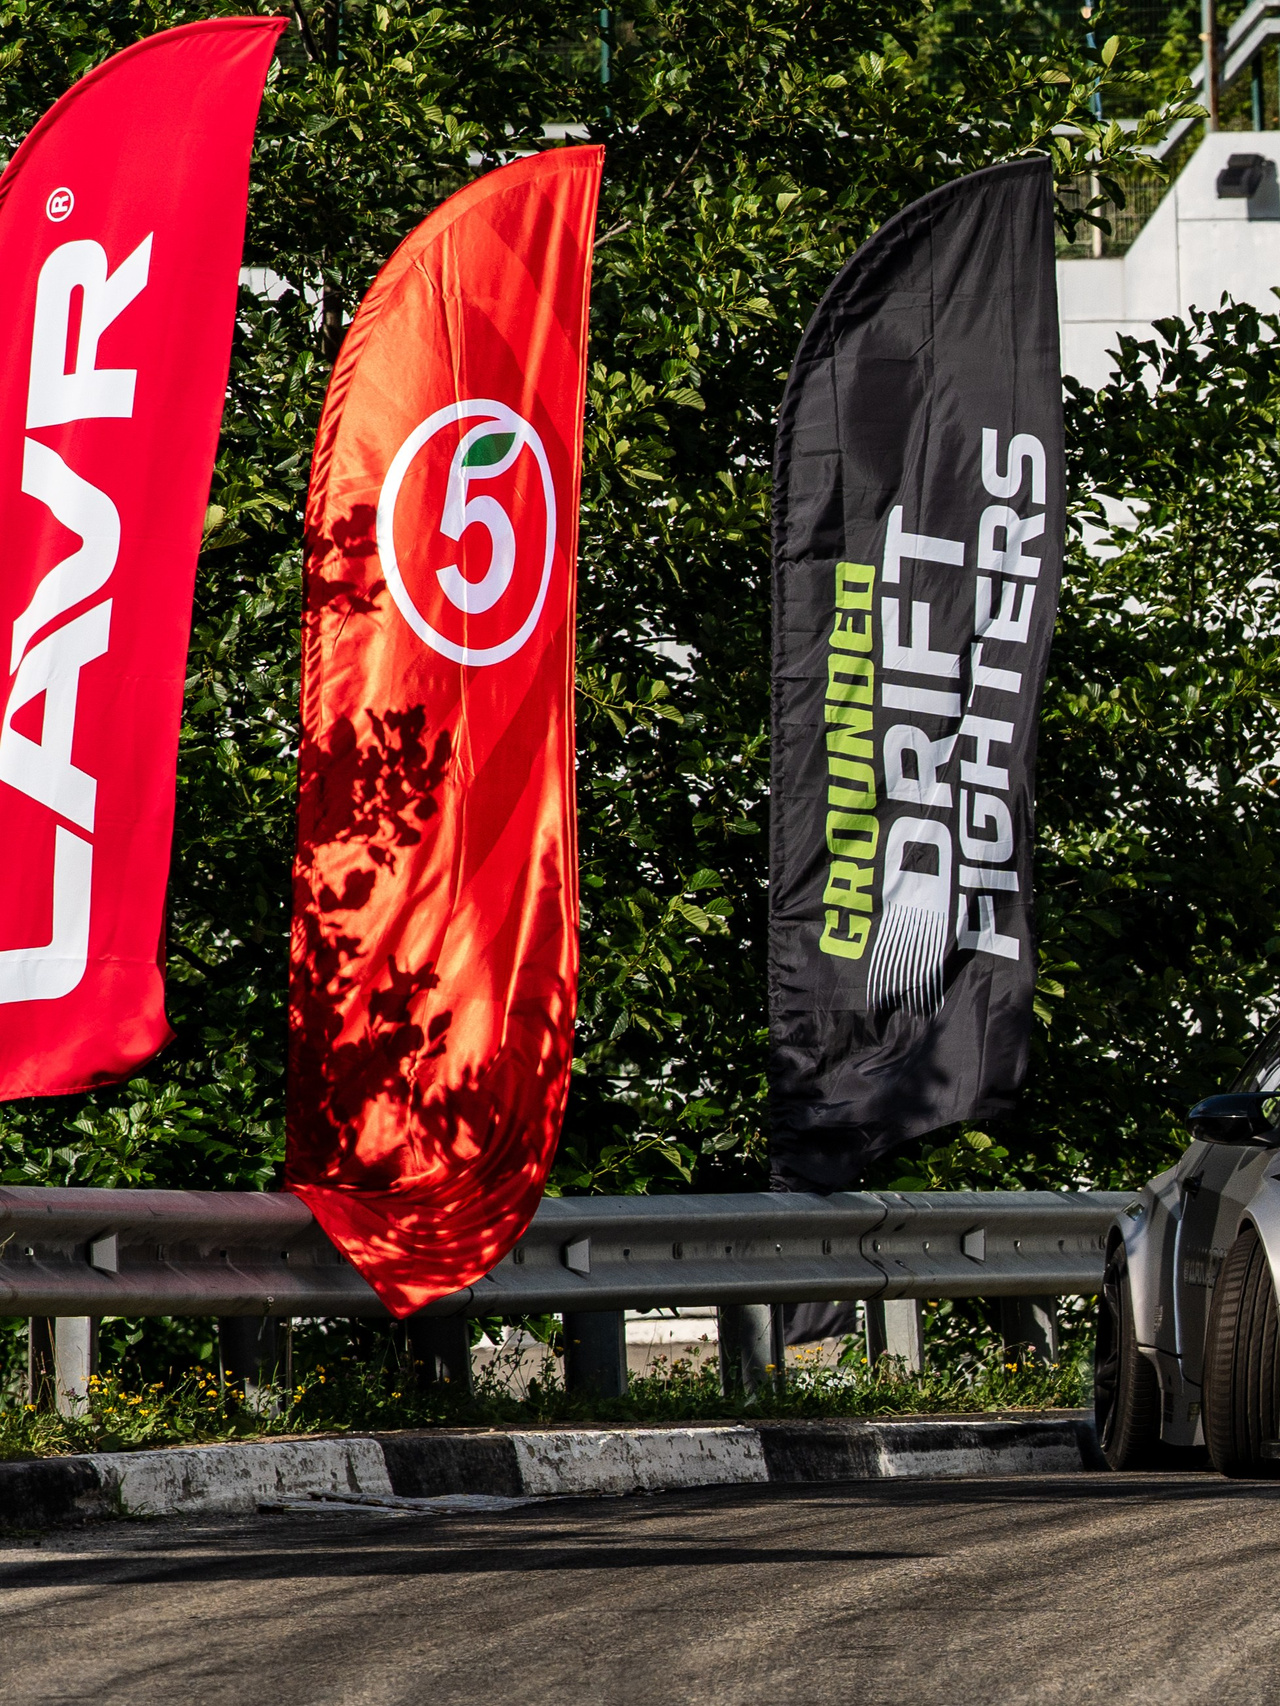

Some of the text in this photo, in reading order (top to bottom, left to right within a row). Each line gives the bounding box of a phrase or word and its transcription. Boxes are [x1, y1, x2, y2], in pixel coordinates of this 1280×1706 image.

[819, 561, 880, 960] GROUNDED
[866, 504, 965, 1020] DRIFT
[956, 427, 1047, 961] FIGHTERS
